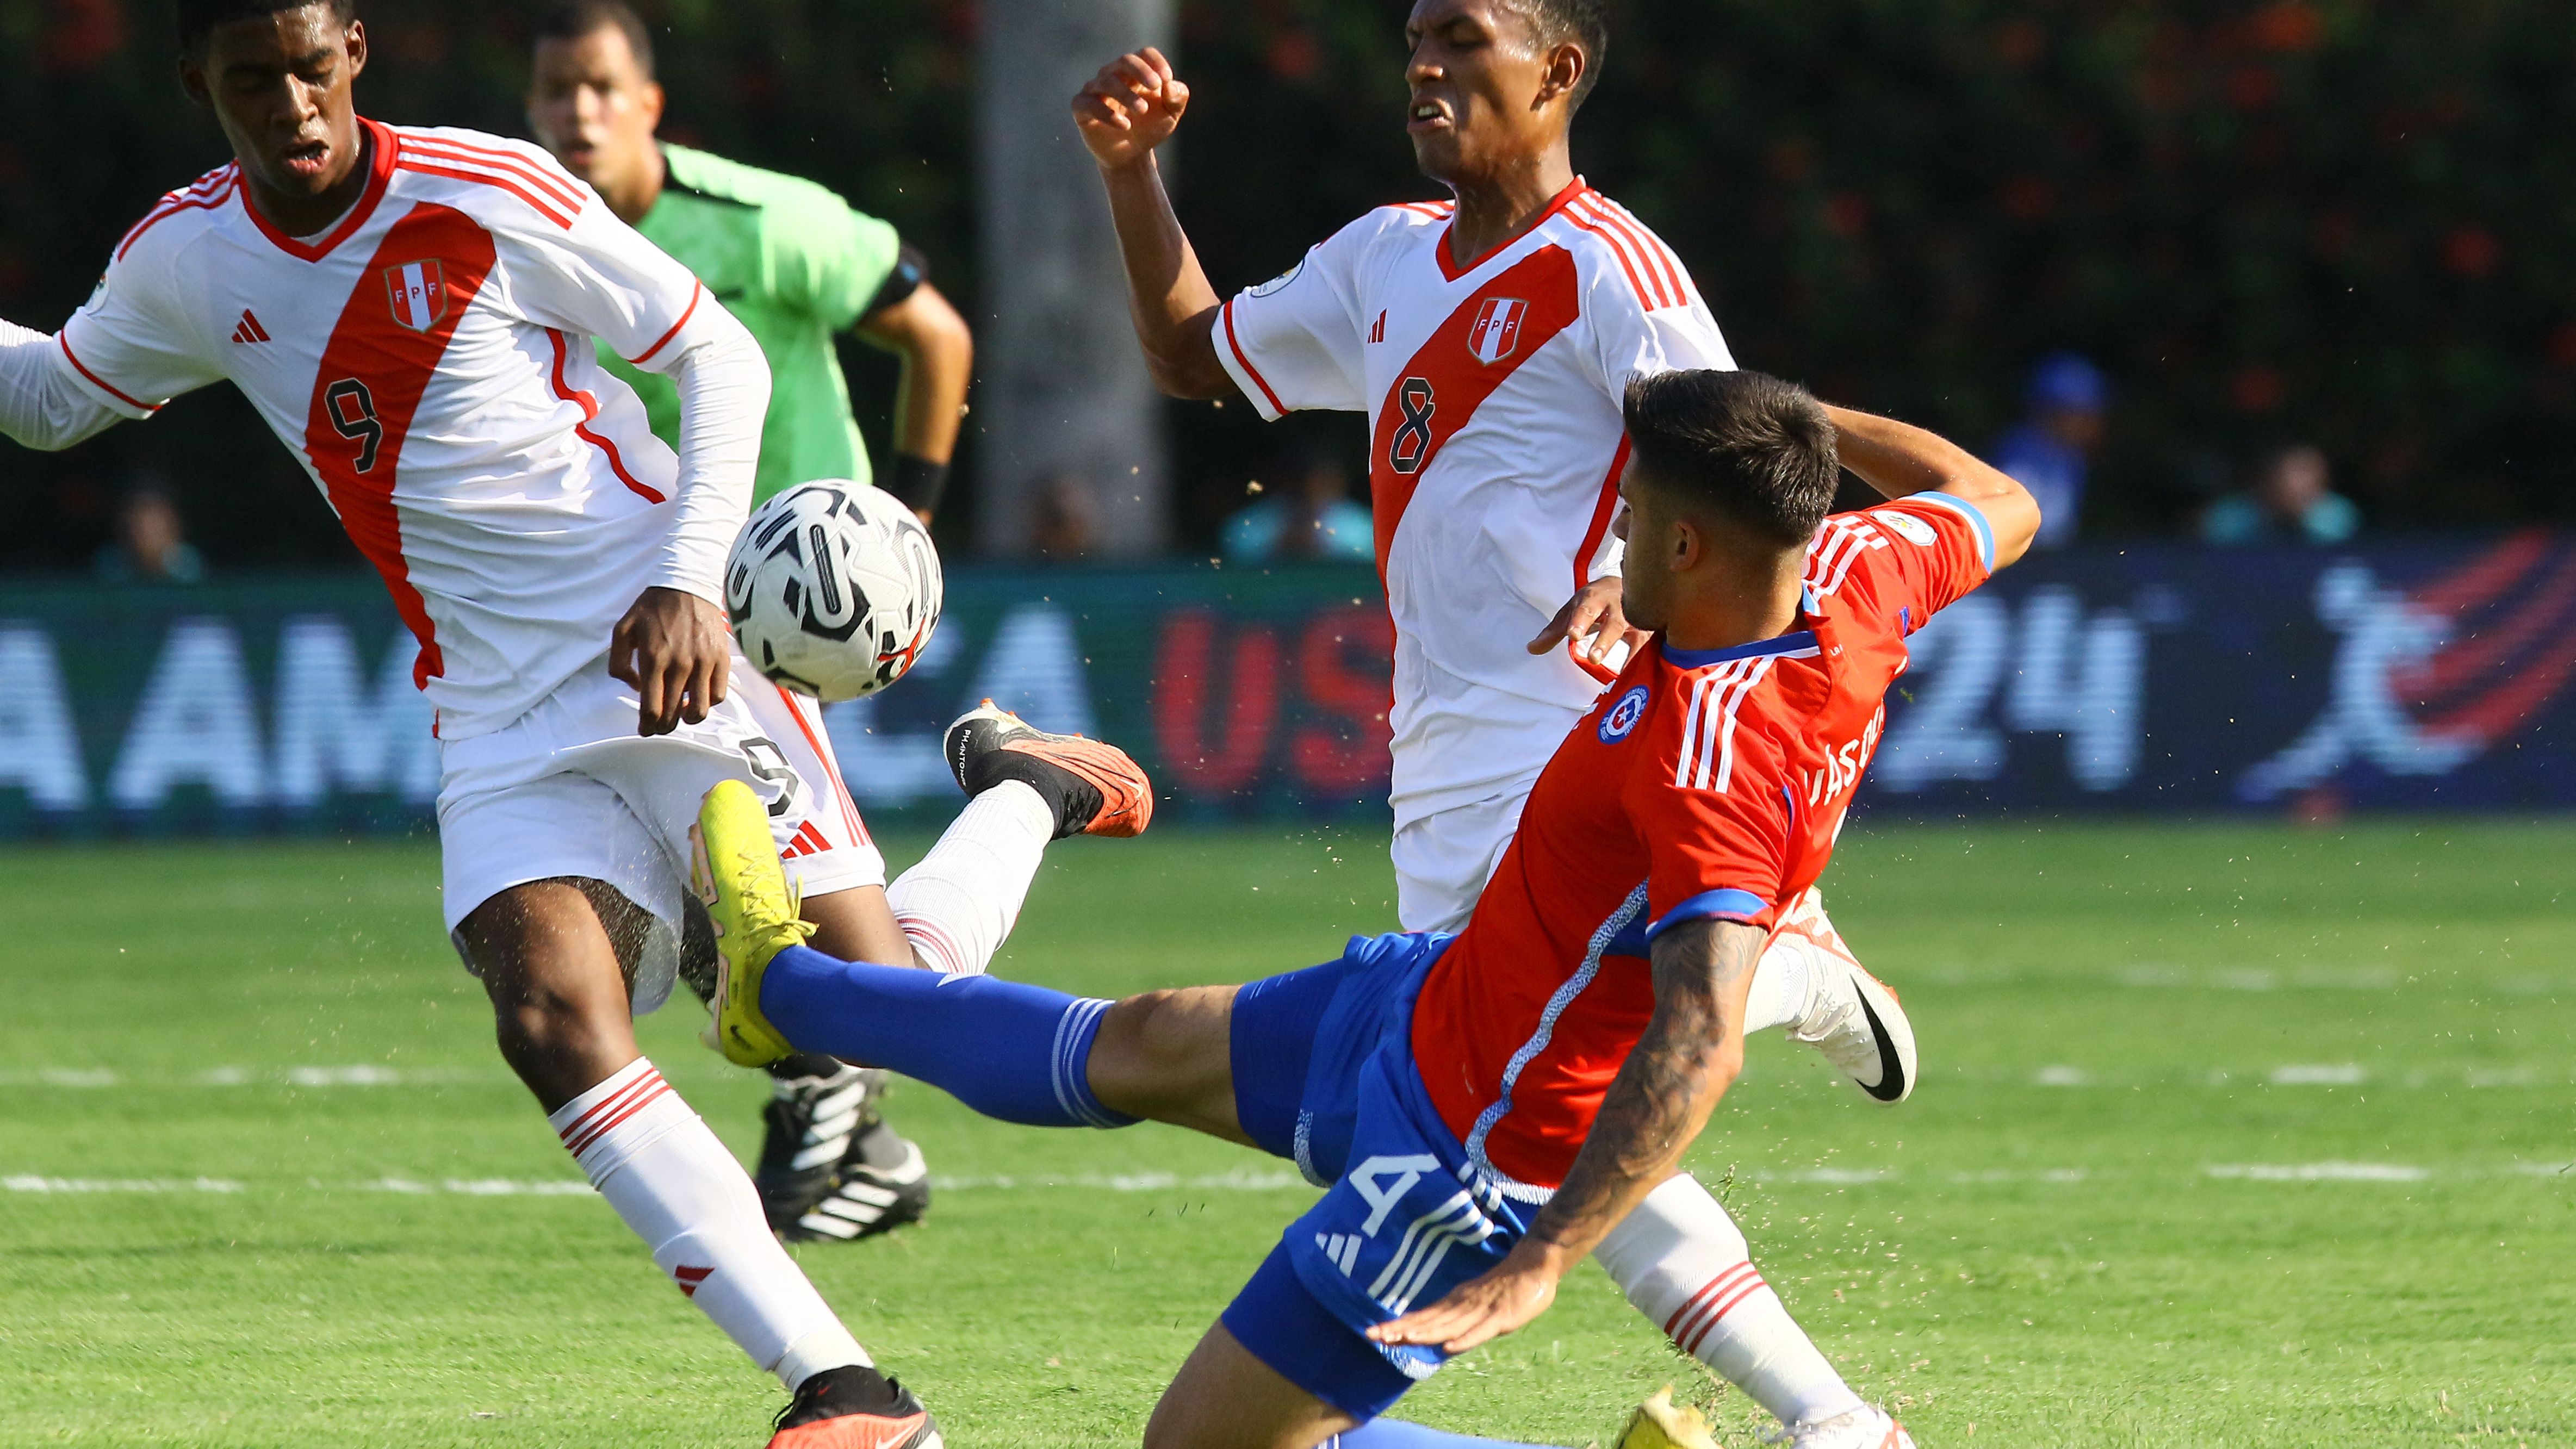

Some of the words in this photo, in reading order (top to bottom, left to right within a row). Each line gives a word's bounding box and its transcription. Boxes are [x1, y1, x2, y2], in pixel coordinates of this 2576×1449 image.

[395, 282, 437, 303] FPF
[1477, 318, 1515, 334] FPF
[325, 377, 383, 474] 9
[1389, 377, 1436, 474] 8
[740, 736, 799, 818] 9
[1348, 1153, 1442, 1239] 4
